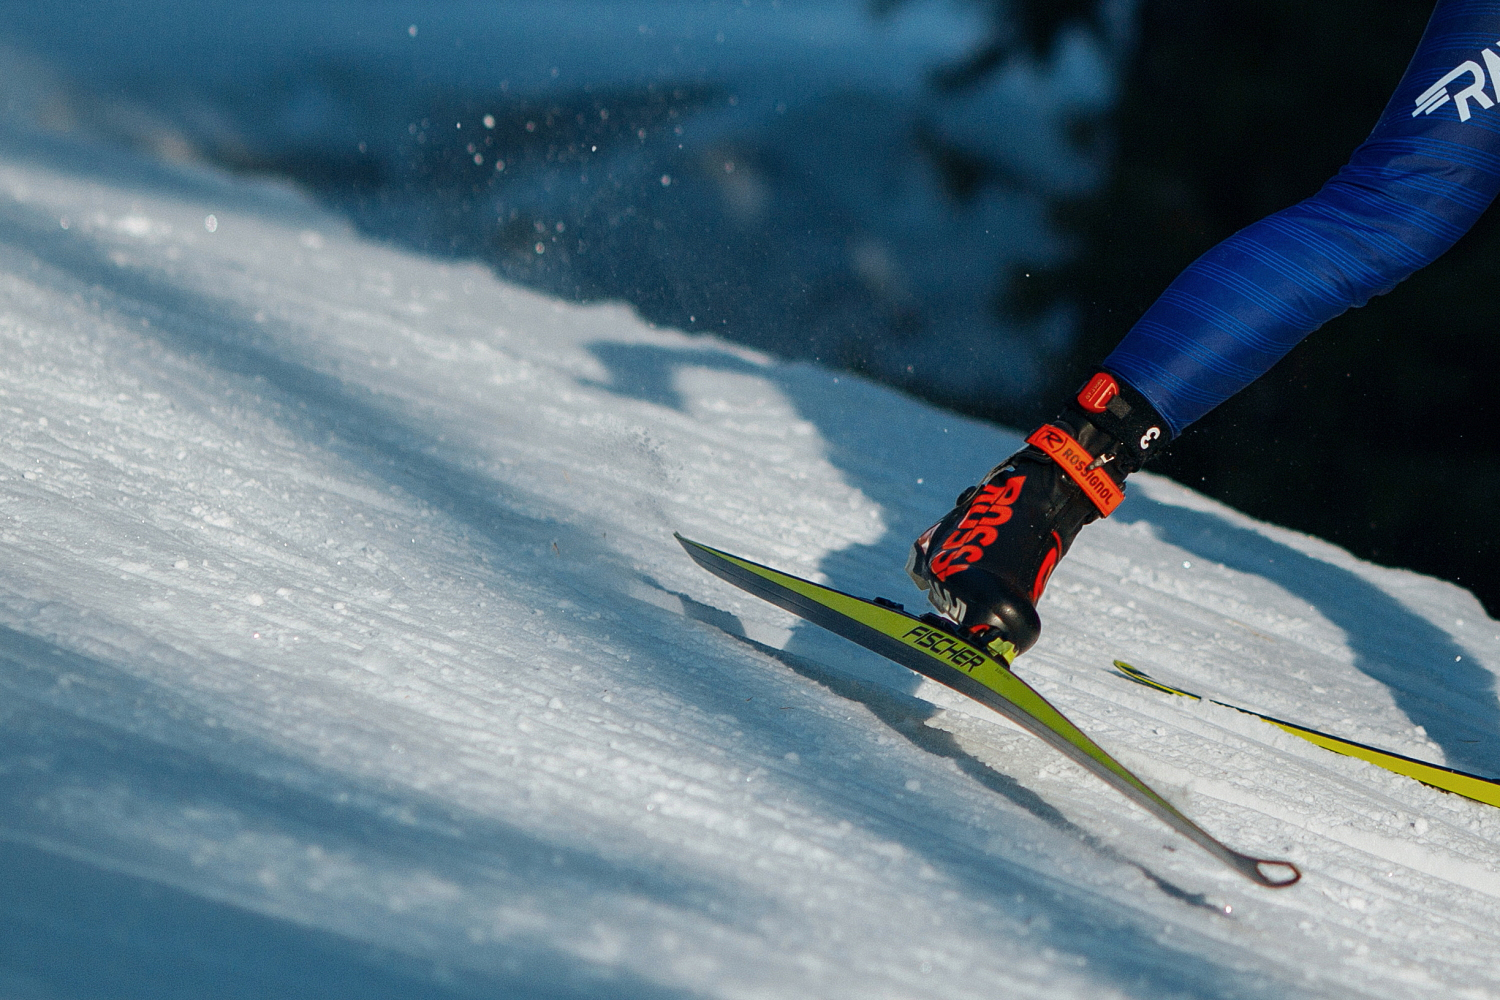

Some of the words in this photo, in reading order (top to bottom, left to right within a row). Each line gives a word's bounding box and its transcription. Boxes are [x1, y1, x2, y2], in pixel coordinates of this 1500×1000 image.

[1140, 426, 1161, 450] 3
[1062, 447, 1113, 506] ROSSIGNOL
[901, 625, 986, 673] FISCHER
